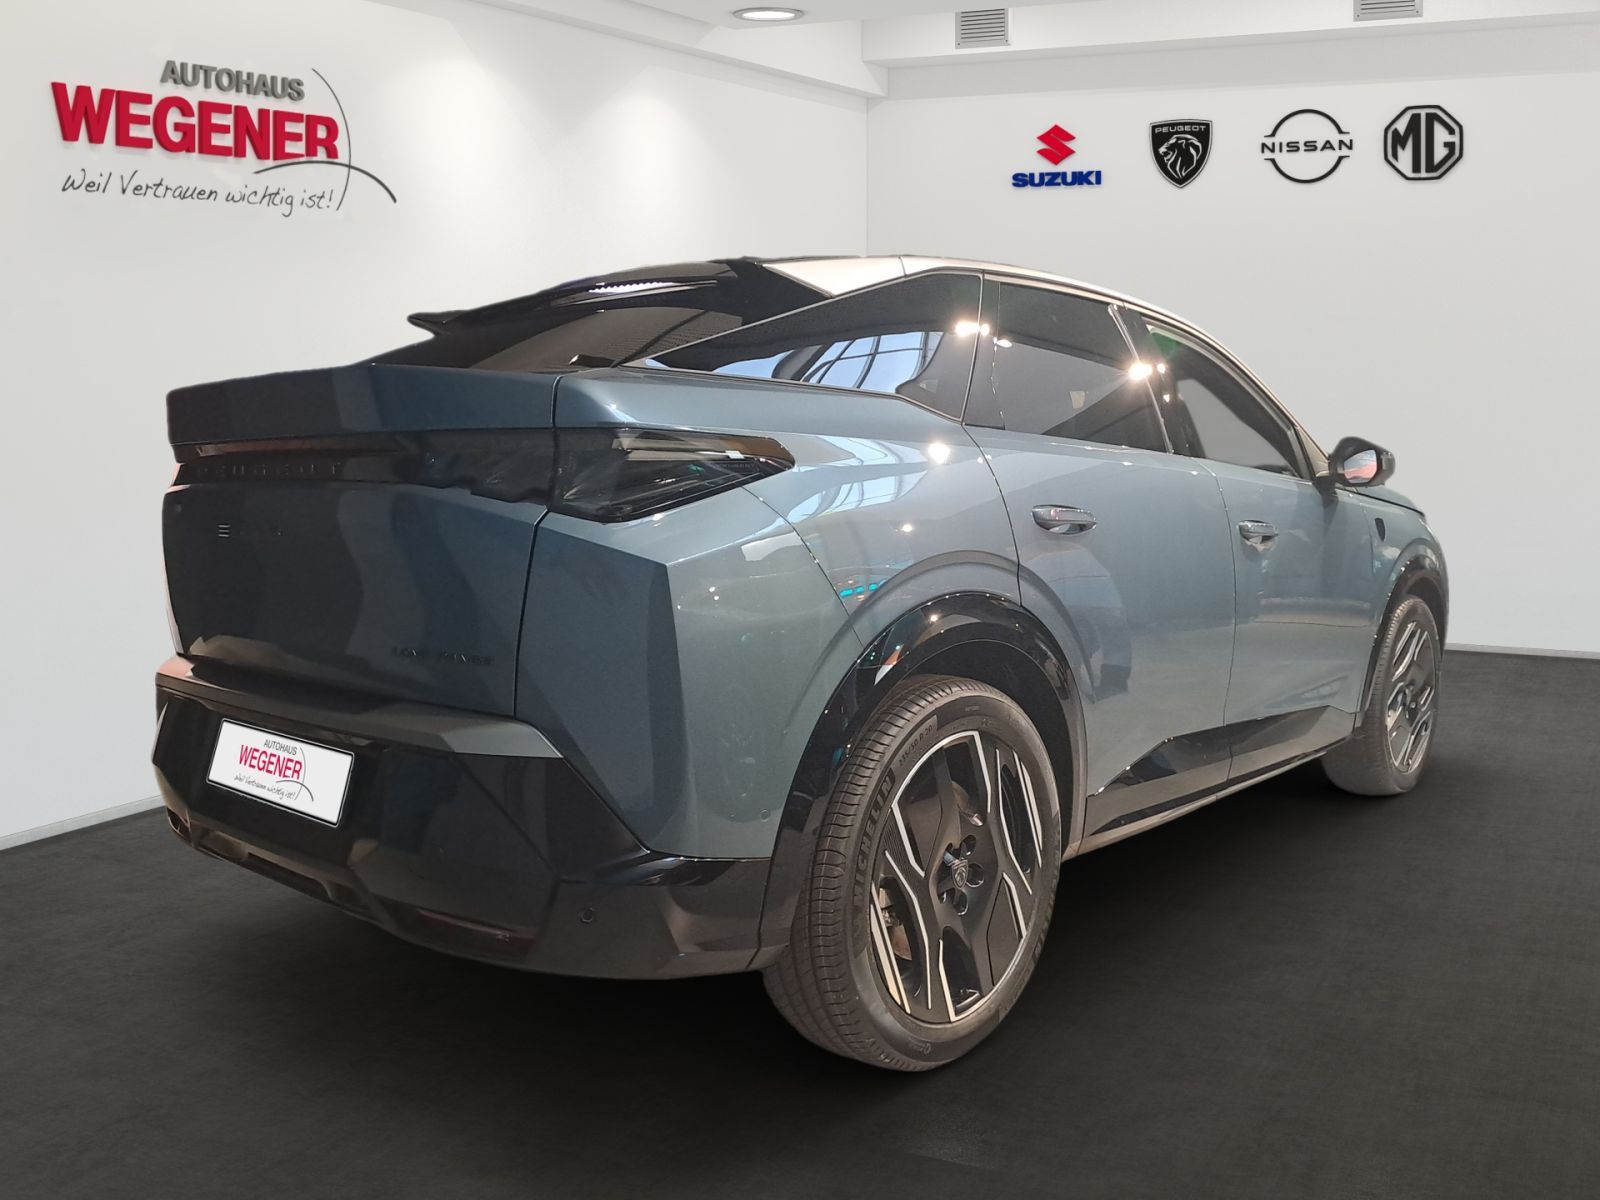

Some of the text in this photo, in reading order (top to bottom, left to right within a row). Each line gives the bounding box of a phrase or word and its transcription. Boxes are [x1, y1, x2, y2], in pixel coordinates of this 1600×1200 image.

[160, 59, 305, 101] AUTOHAUS
[50, 81, 340, 161] WEGENER
[1154, 125, 1207, 134] PEUGEOT
[1260, 138, 1354, 155] NISSAN
[1391, 110, 1456, 175] MG
[61, 168, 333, 217] Weil Vertrauen wichtig ist!
[1011, 169, 1102, 188] SUZUKI
[239, 744, 303, 780] WEGENER
[263, 739, 298, 756] AUTOHAUS
[853, 774, 895, 907] MICHELIN
